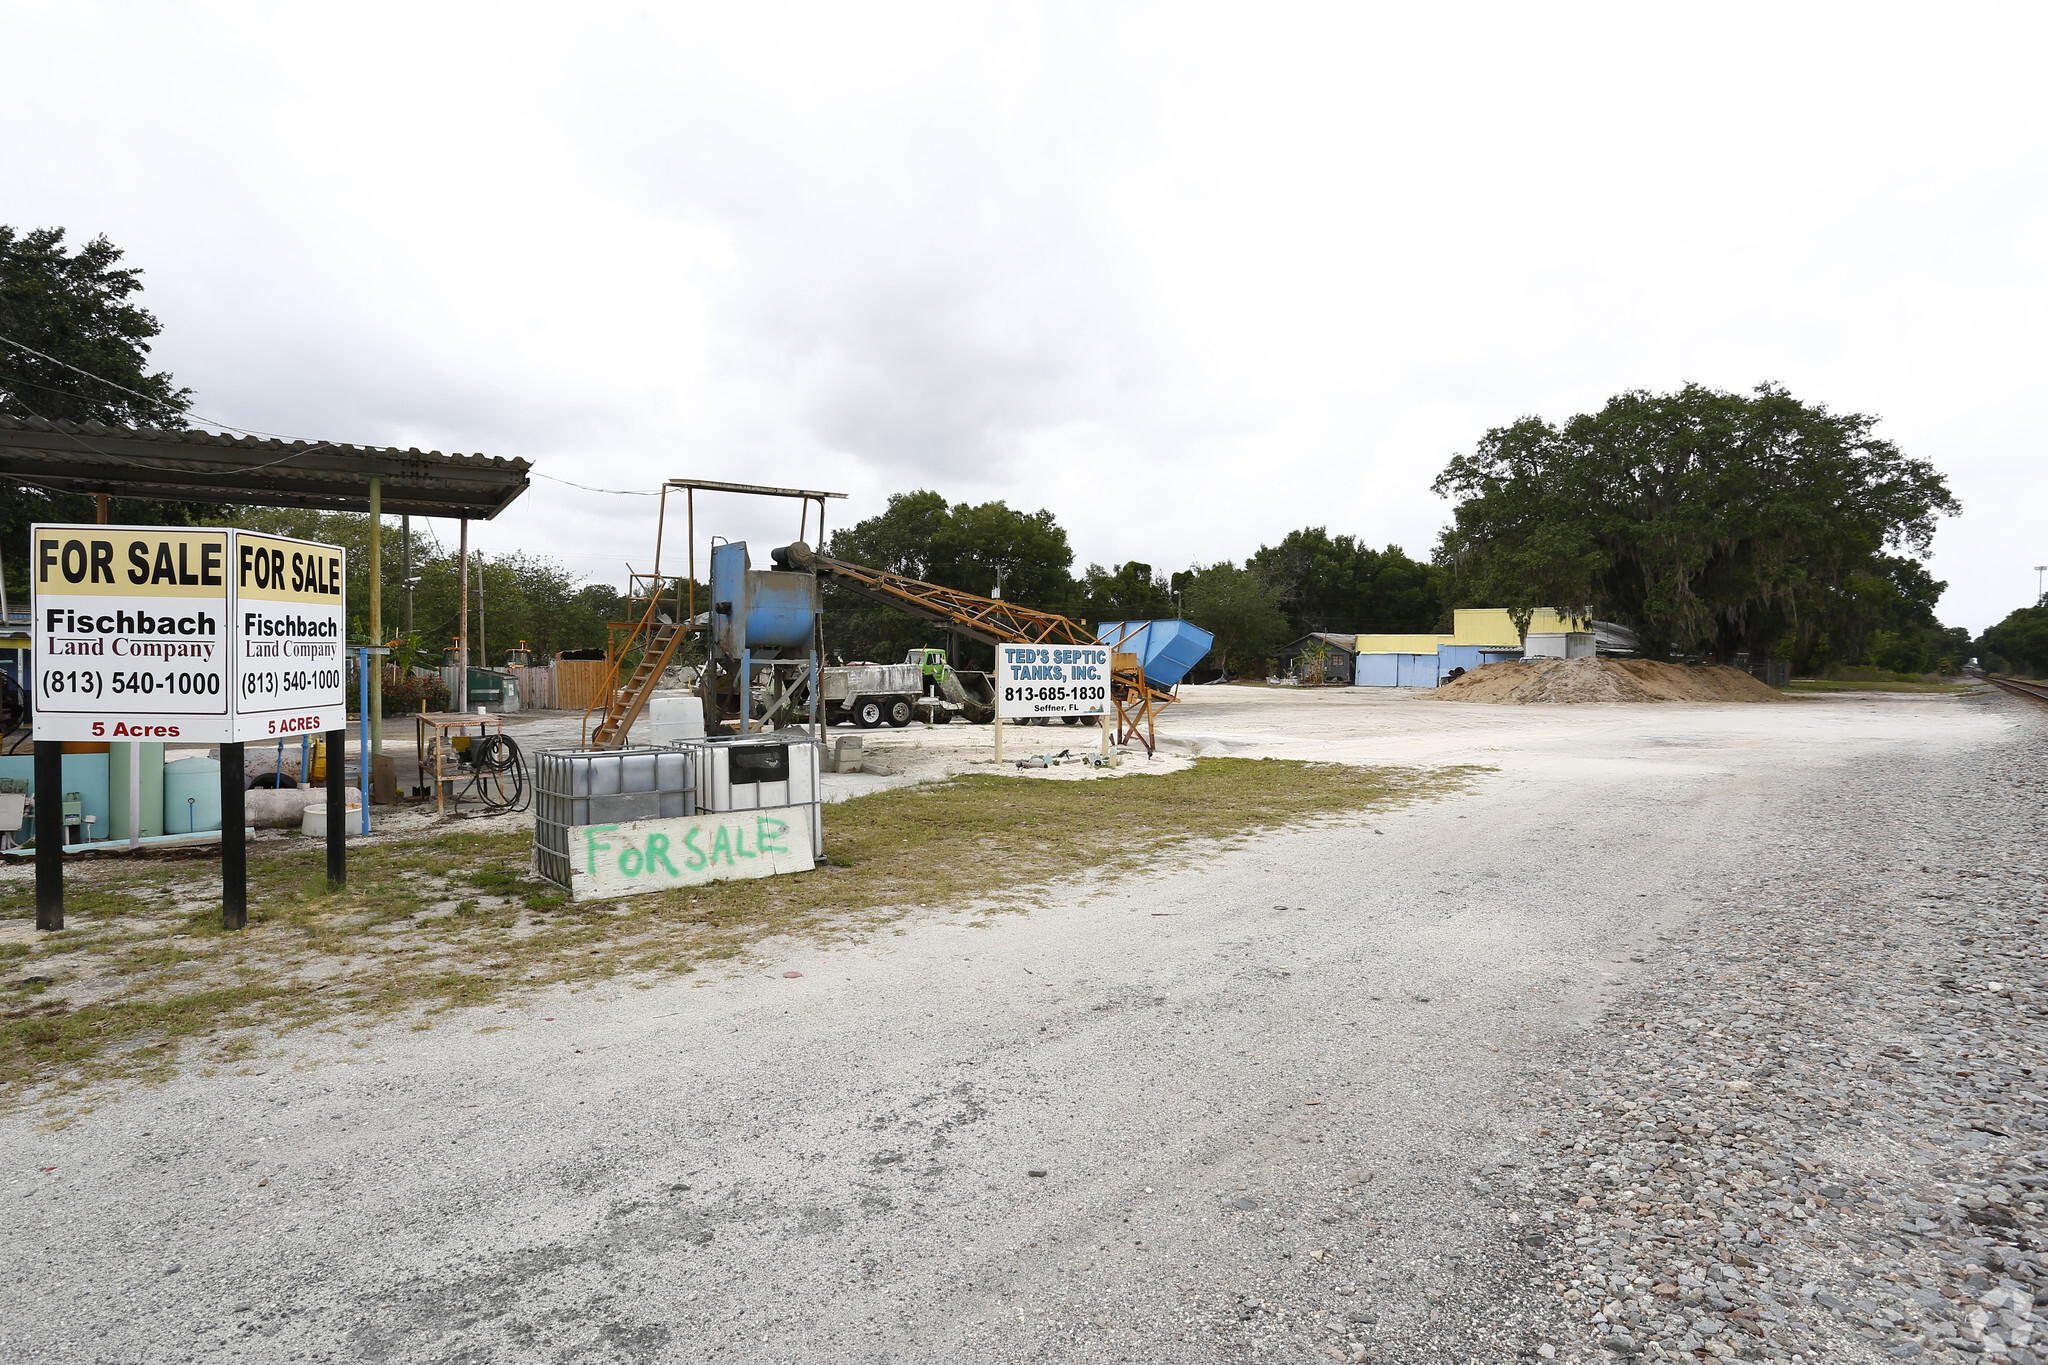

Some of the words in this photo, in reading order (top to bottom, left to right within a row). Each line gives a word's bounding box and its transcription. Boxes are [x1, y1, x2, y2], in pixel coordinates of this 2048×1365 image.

[40, 539, 115, 584] FOR
[127, 541, 222, 586] SALE
[240, 545, 286, 590] FOR
[292, 552, 340, 595] SALE
[46, 608, 216, 635] Fischbach
[245, 613, 337, 637] Fischbach
[47, 637, 104, 656] Land
[112, 638, 216, 662] Company
[245, 639, 279, 658] Land
[283, 641, 337, 661] Company
[1005, 649, 1049, 664] TED'S
[1053, 650, 1106, 665] SEPTIC
[42, 670, 103, 699] (813)
[112, 672, 220, 695] 540-1000
[242, 672, 278, 700] (813)
[283, 669, 340, 693] 540-1000
[1011, 665, 1067, 683] TANKS,
[1071, 665, 1101, 680] INC.
[1005, 686, 1105, 701] 813-685-1830
[1034, 704, 1067, 712] Seffner,
[1069, 703, 1079, 711] FL
[92, 722, 105, 737] 5
[113, 722, 180, 737] Acres
[268, 720, 277, 734] 5
[280, 716, 320, 733] ACRES
[684, 817, 789, 871] SALE
